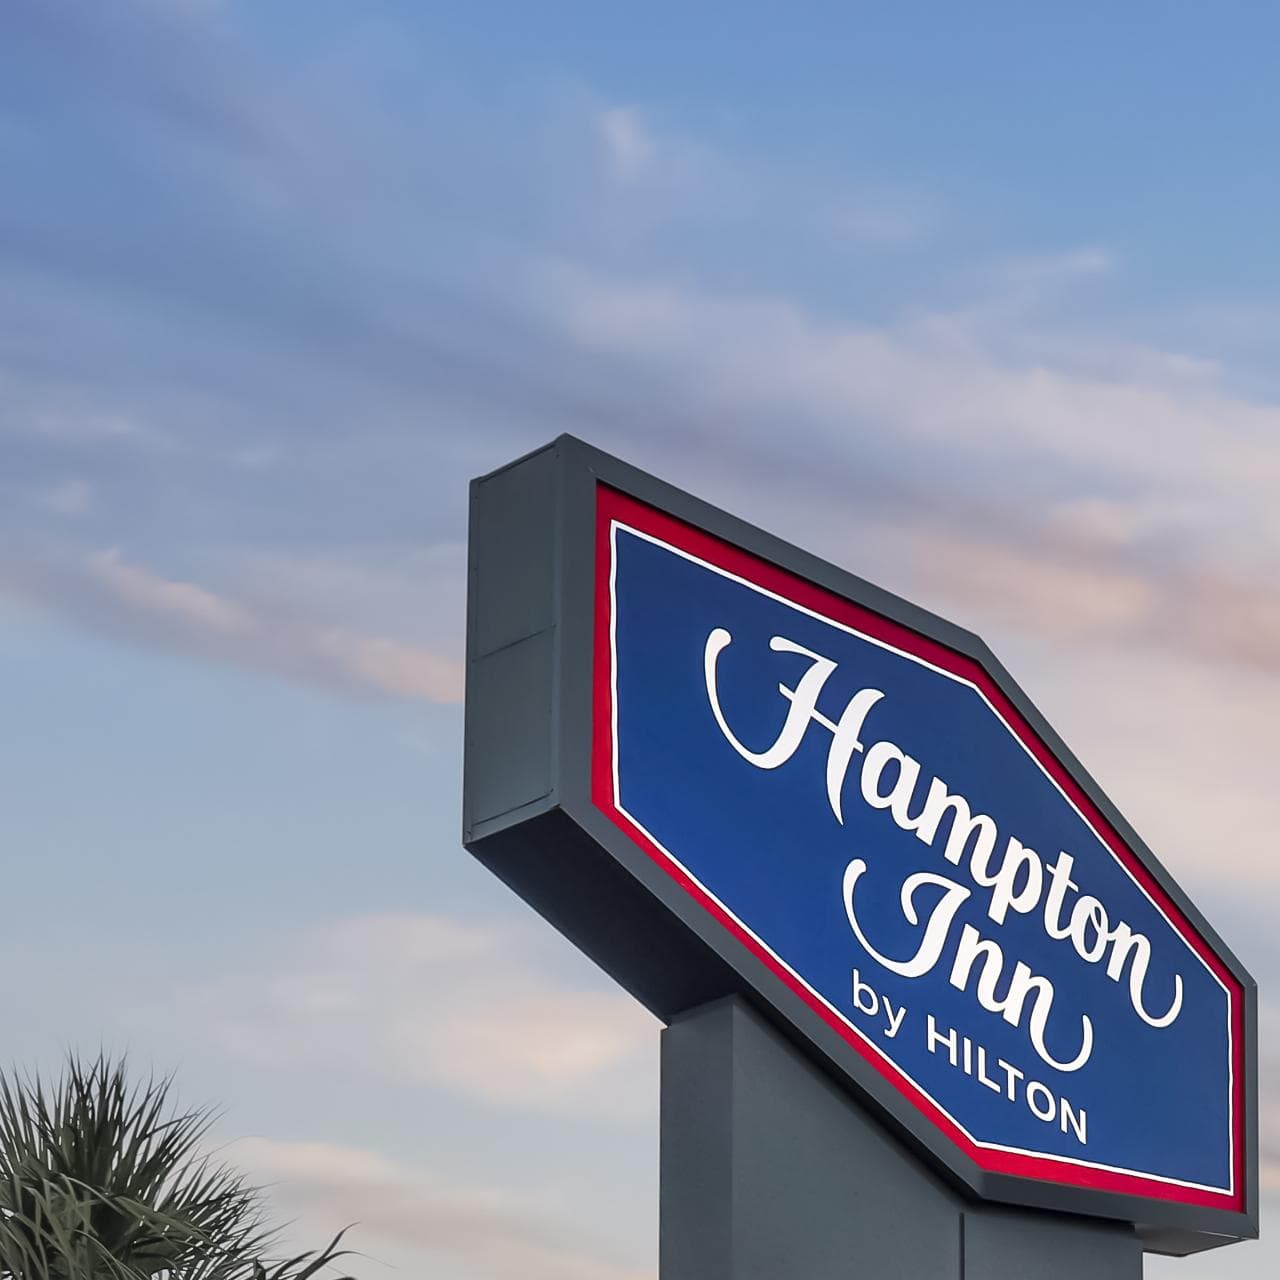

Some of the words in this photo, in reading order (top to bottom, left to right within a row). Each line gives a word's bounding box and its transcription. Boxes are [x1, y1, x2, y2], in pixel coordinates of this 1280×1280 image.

[704, 627, 1183, 1028] Hampton
[842, 858, 1093, 1072] Inn
[853, 968, 907, 1038] by
[927, 1014, 1087, 1145] HILTON
